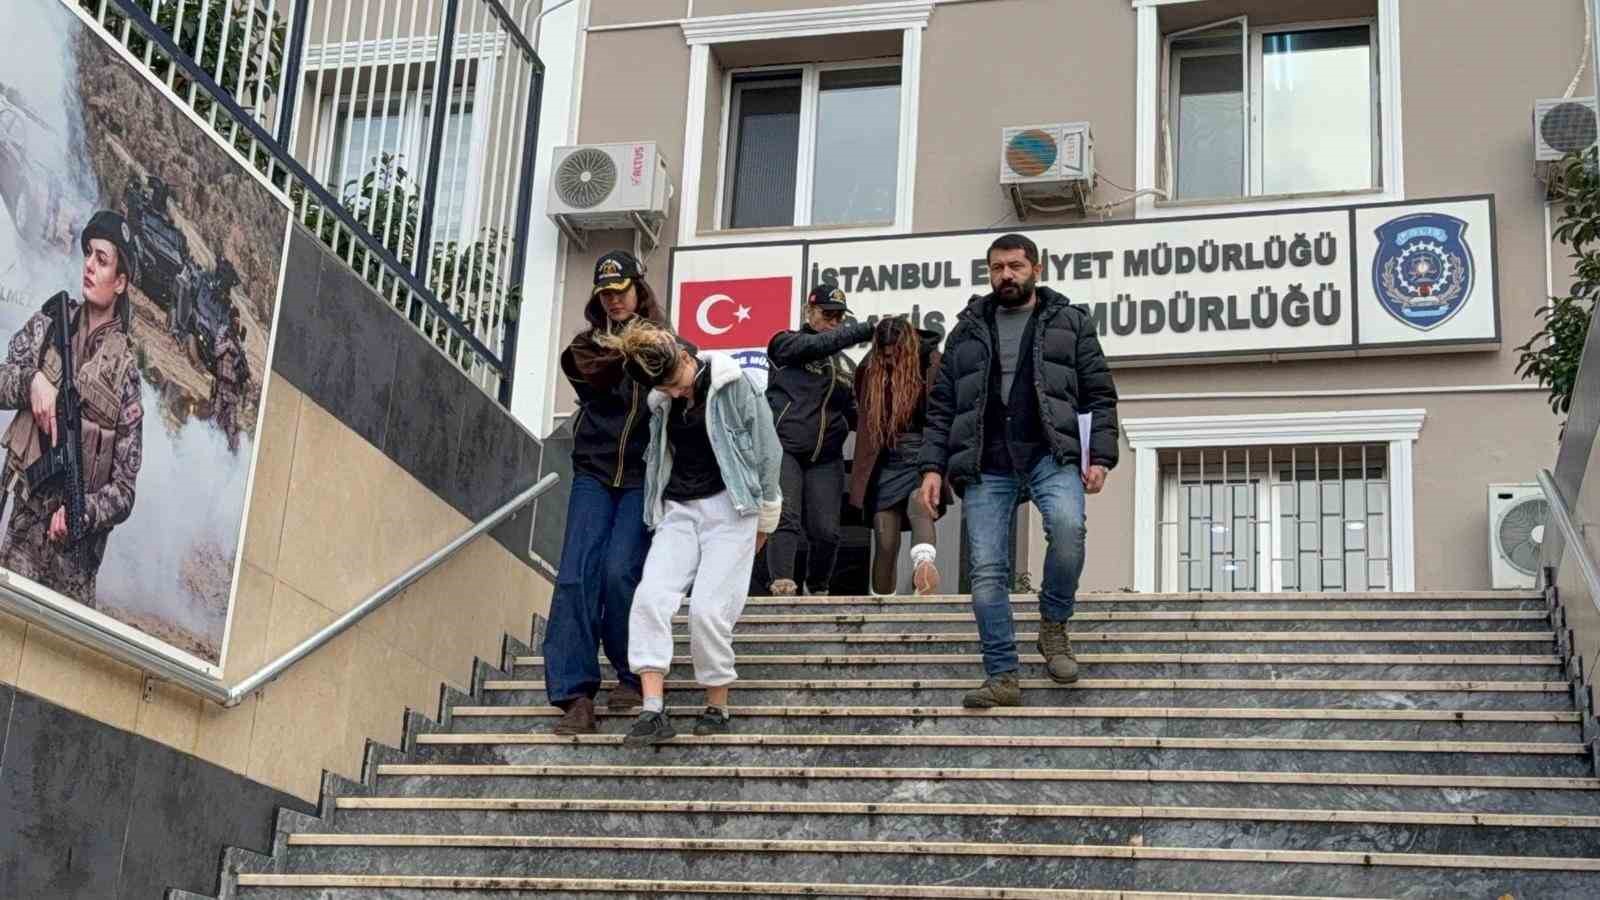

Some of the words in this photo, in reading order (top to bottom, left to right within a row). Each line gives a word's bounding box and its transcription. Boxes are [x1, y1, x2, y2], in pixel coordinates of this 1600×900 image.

[632, 146, 645, 177] ALTUS
[811, 261, 961, 293] İSTANBUL
[971, 247, 1114, 286] EİYET
[1123, 231, 1337, 277] MÜDÜRLÜĞÜ
